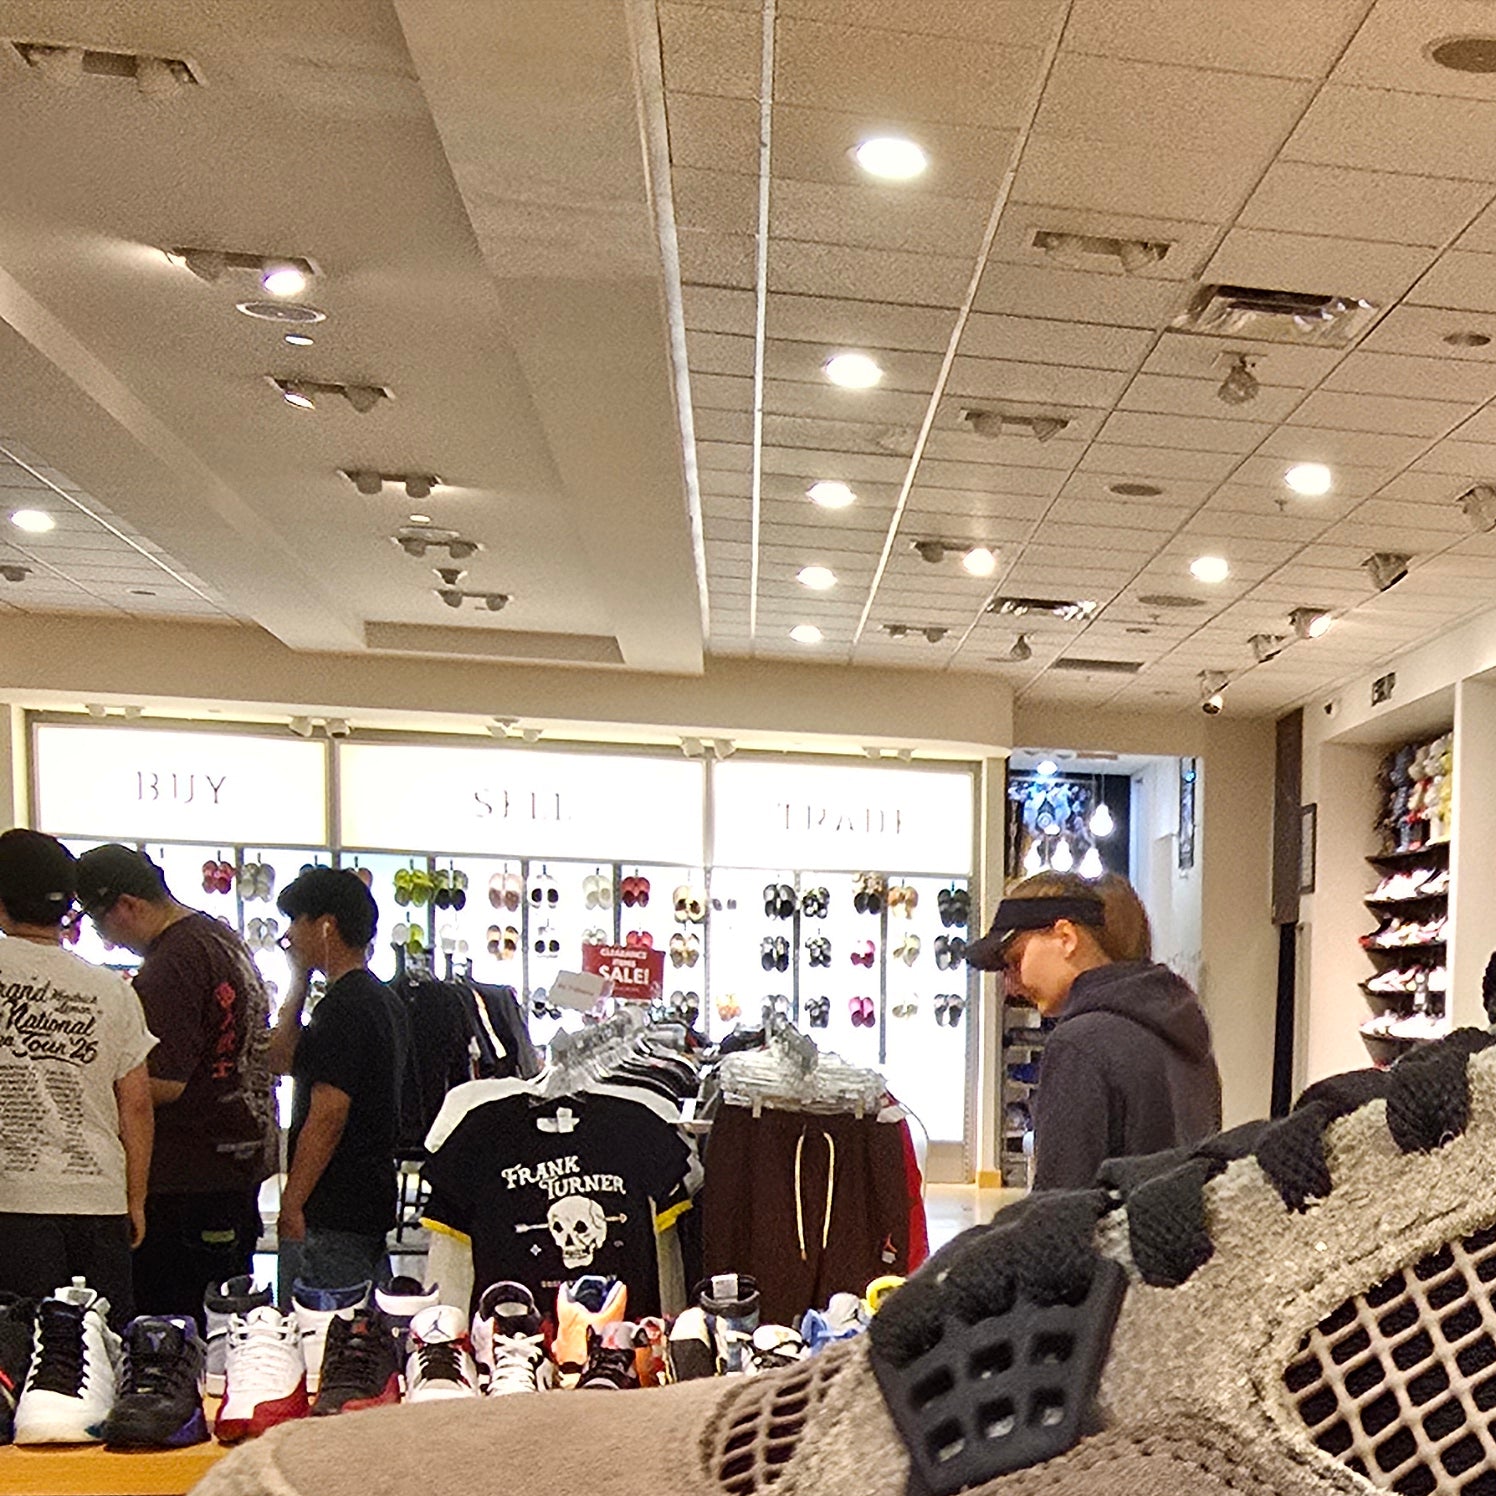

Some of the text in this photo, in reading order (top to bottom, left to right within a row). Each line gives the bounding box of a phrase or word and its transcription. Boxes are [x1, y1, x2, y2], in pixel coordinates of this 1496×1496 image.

[136, 770, 227, 805] BUY
[2, 999, 97, 1037] National
[12, 1033, 67, 1058] Tour
[501, 1155, 581, 1190] FRANK
[538, 1173, 627, 1200] TURNER
